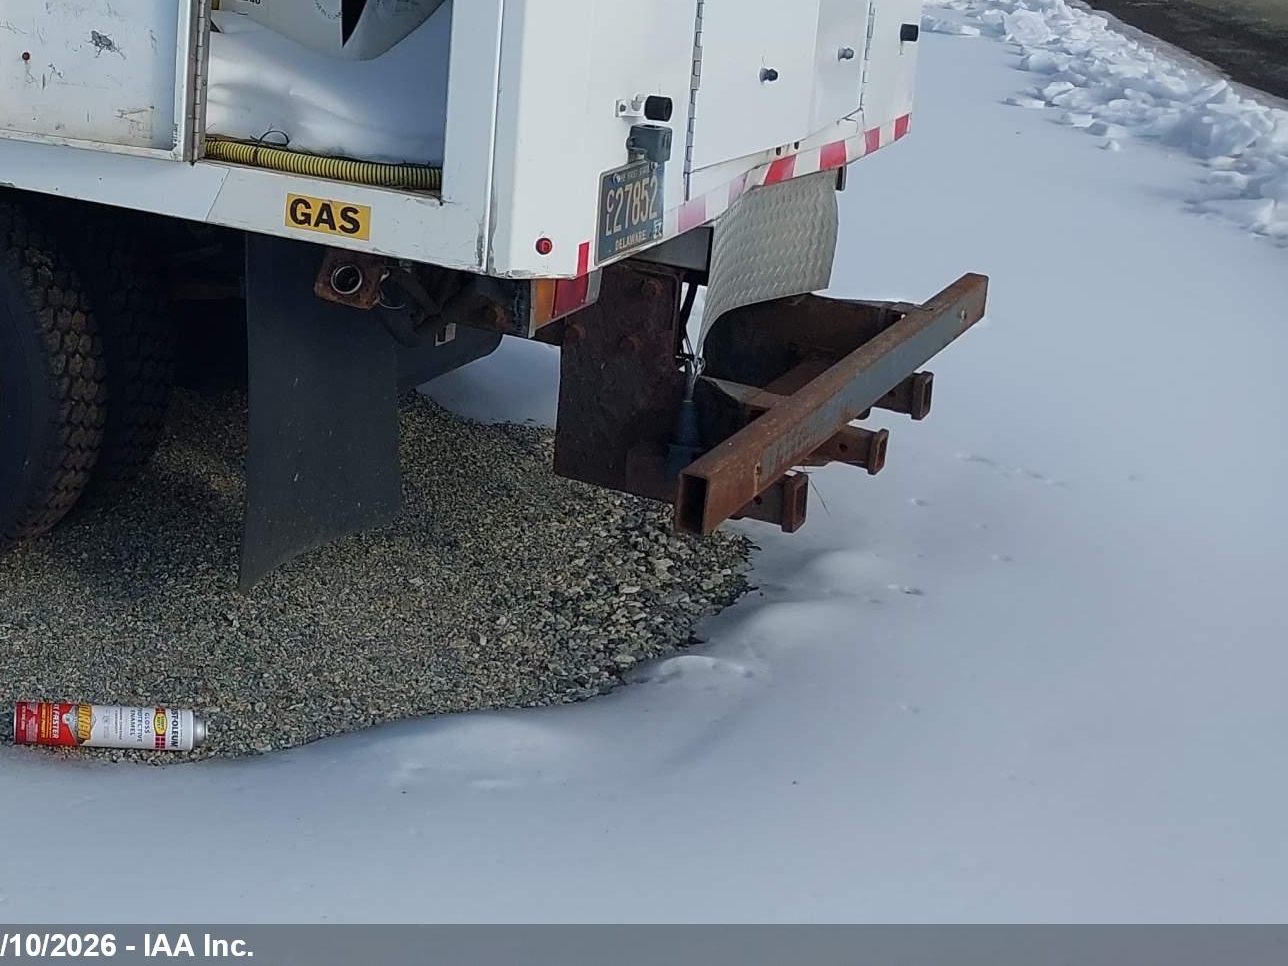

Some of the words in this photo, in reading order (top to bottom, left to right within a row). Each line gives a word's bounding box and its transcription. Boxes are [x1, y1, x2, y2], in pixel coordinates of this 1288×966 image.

[289, 198, 361, 234] GAS
[613, 176, 658, 234] 27852
[615, 229, 648, 252] DELAWARE
[52, 710, 60, 739] FASTER
[170, 707, 179, 747] UST-OLEUM
